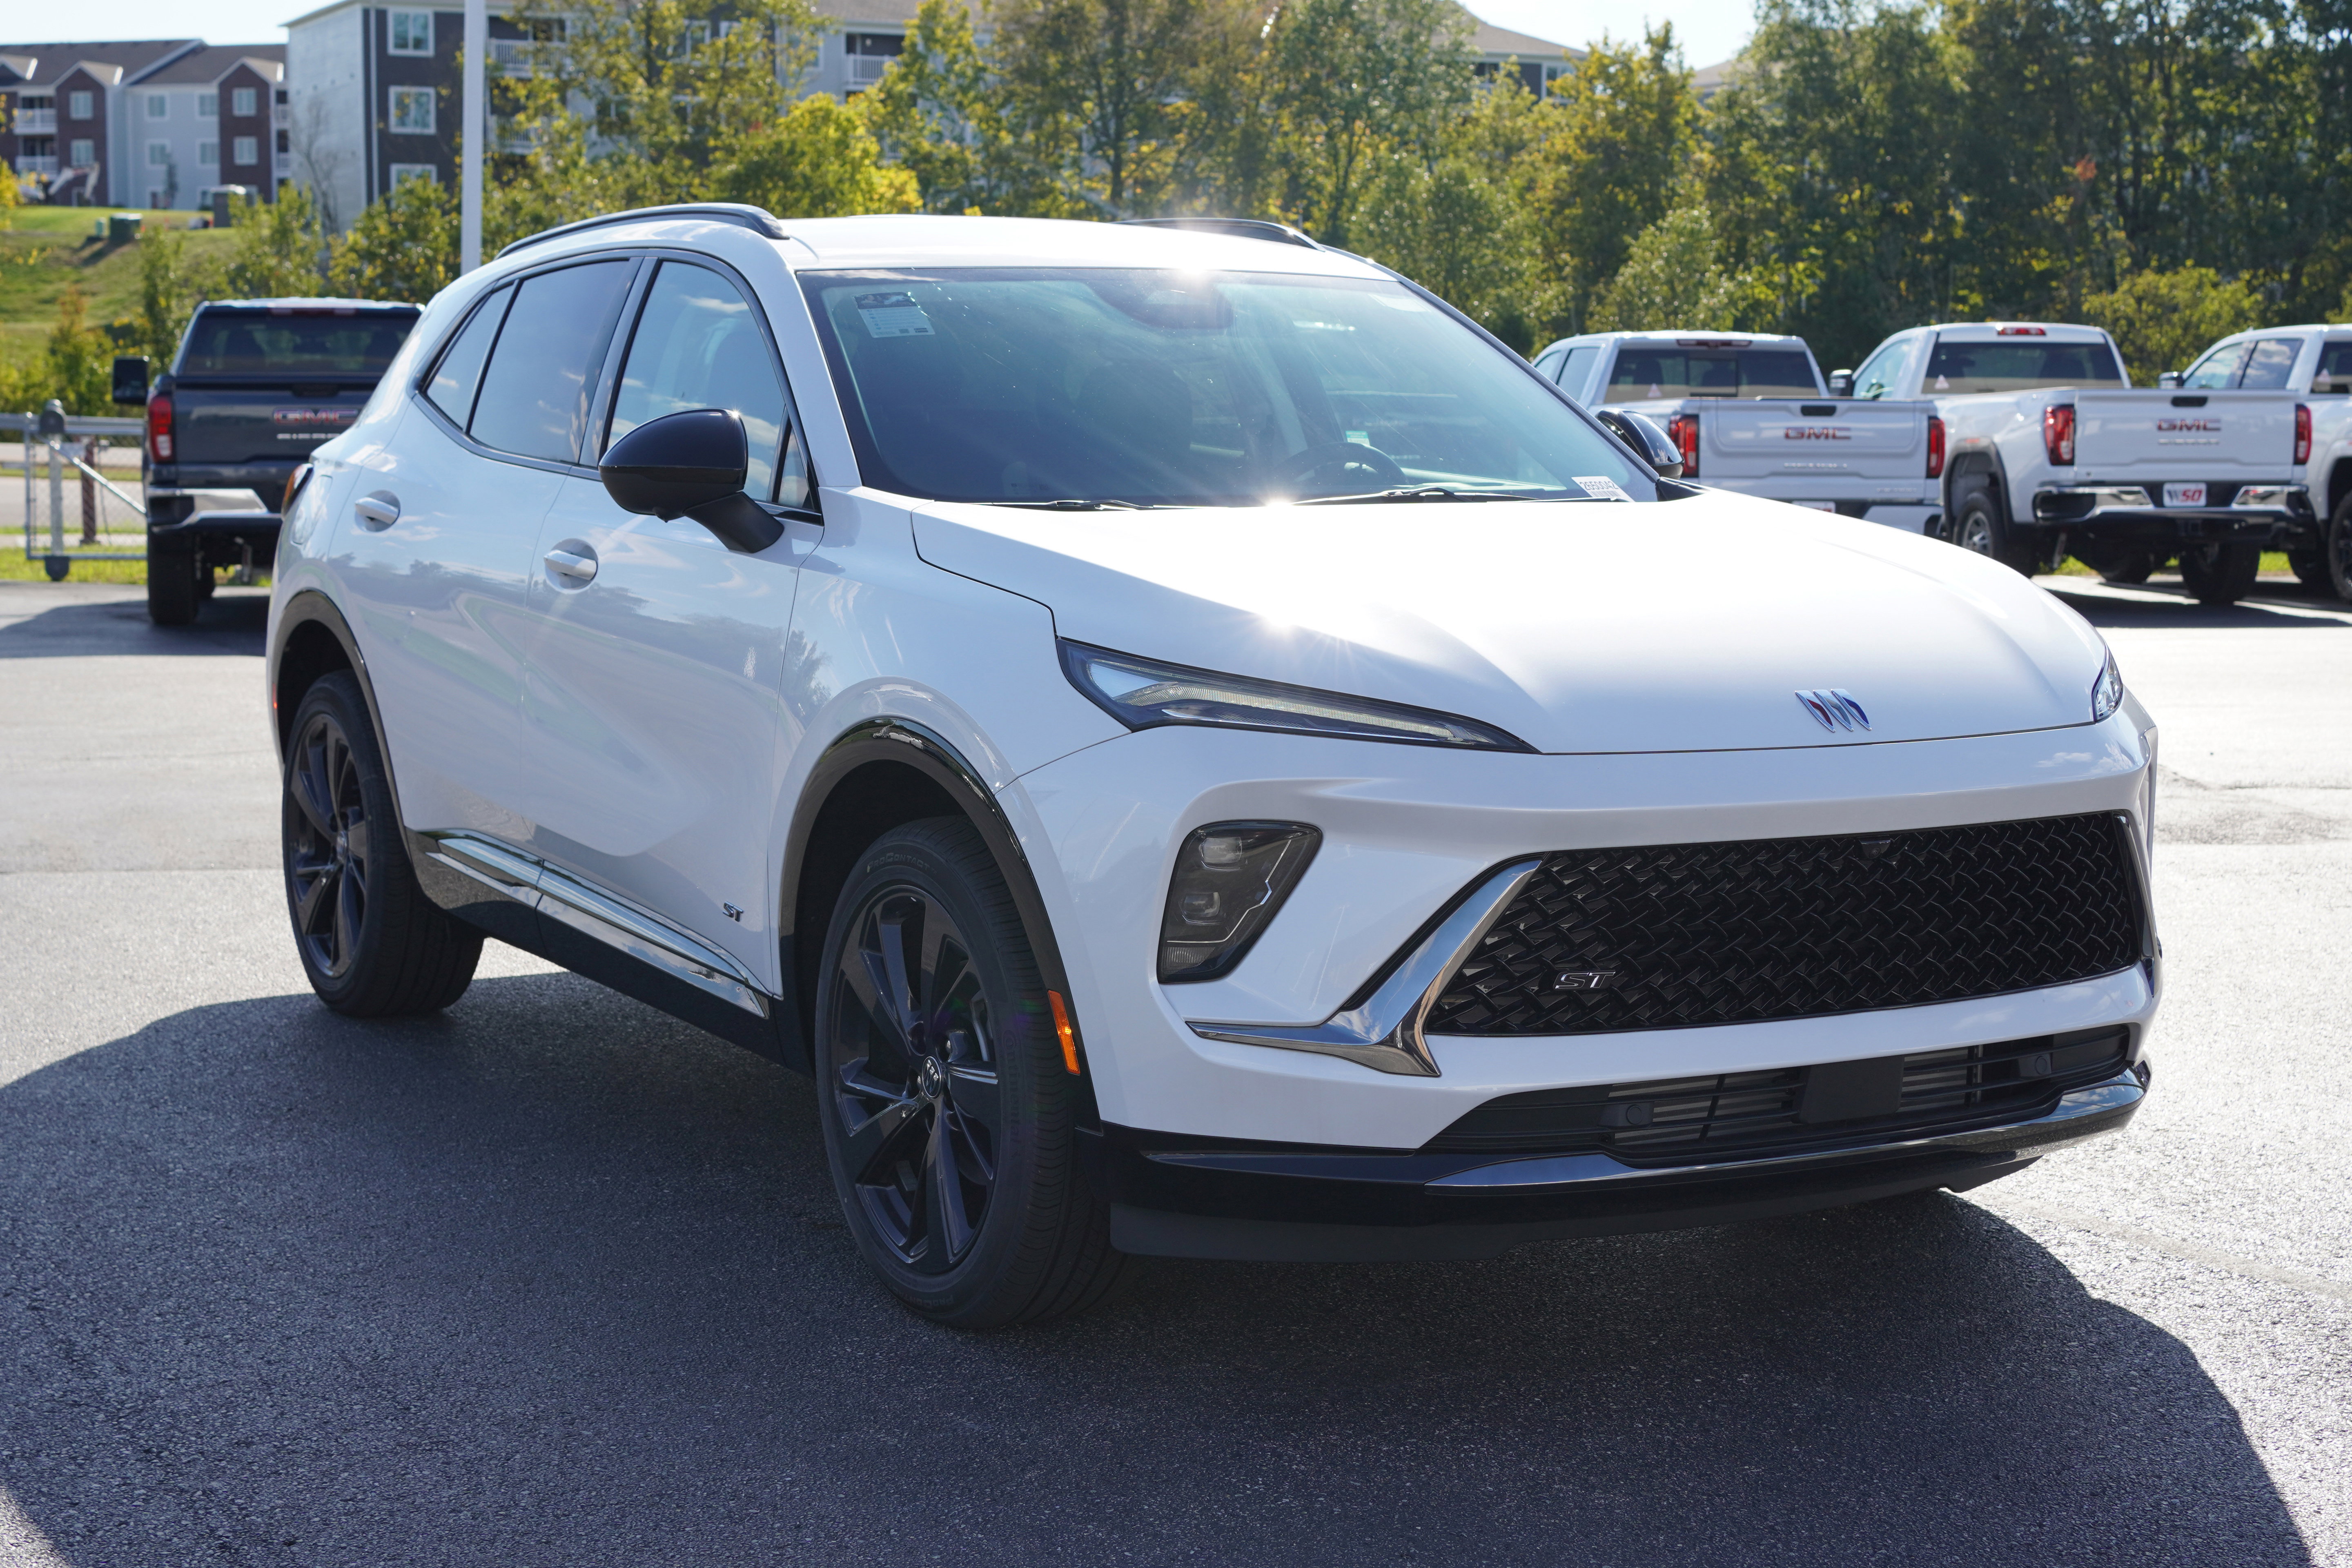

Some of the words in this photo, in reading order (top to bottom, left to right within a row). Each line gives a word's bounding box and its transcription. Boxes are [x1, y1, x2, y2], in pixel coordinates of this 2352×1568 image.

[274, 408, 358, 425] GMC
[2157, 418, 2221, 432] GMC
[1785, 427, 1851, 440] GMC
[1579, 481, 1619, 490] 2650042
[722, 901, 744, 922] ST
[1554, 971, 1616, 989] ST
